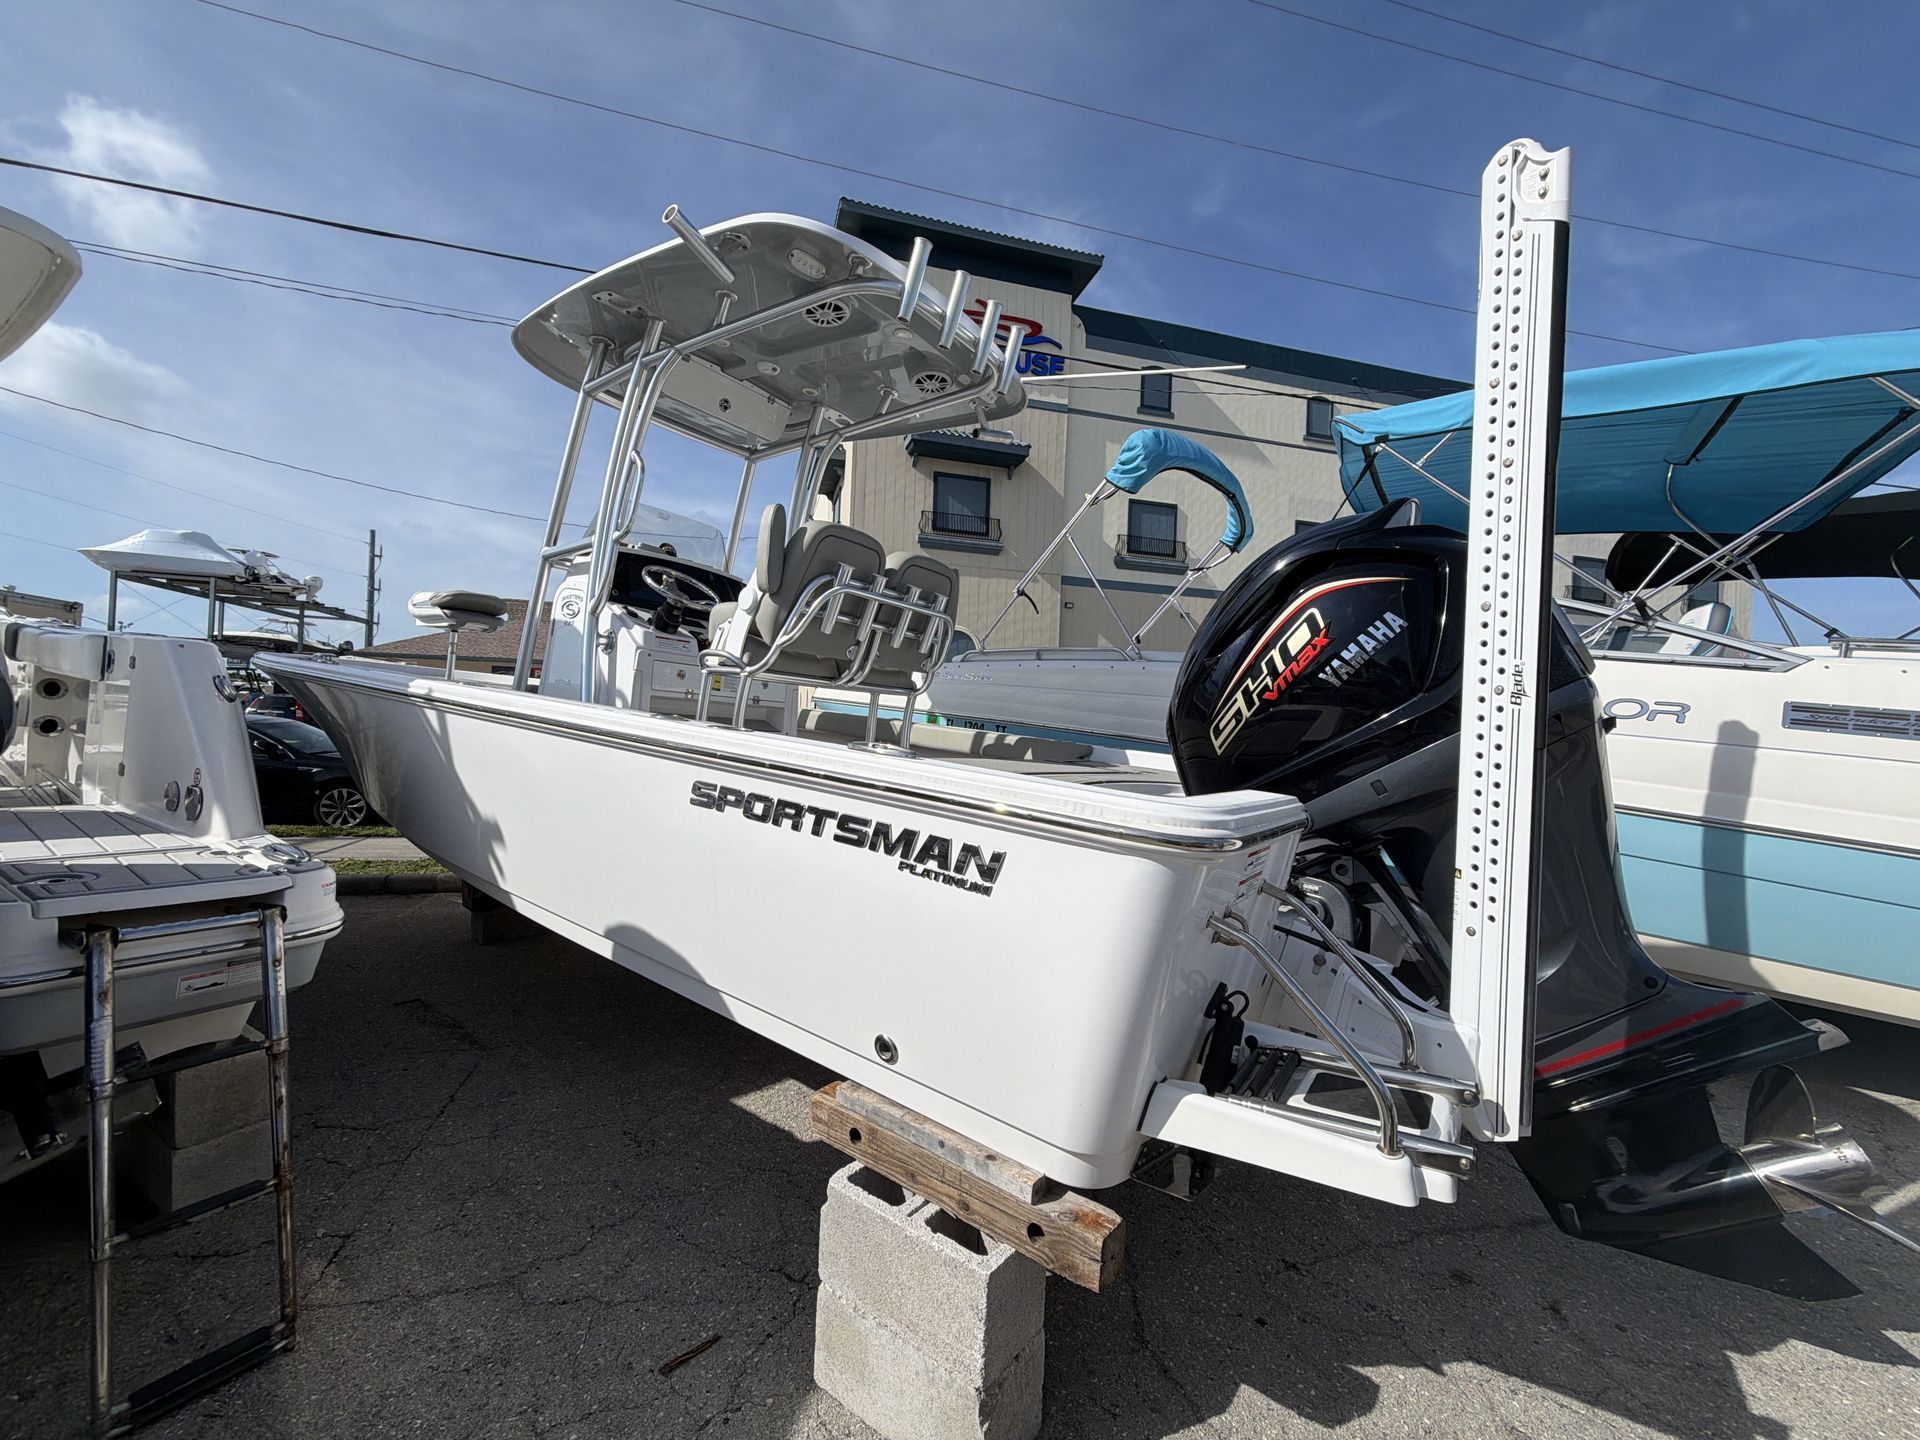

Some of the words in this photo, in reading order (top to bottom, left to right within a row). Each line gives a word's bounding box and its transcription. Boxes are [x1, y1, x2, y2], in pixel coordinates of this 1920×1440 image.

[1209, 607, 1325, 756] SHO
[1317, 611, 1409, 688] YAMAHA
[1510, 664, 1531, 706] Blade
[690, 780, 1007, 884] SPORTSMAN
[897, 860, 993, 897] PLATINUM
